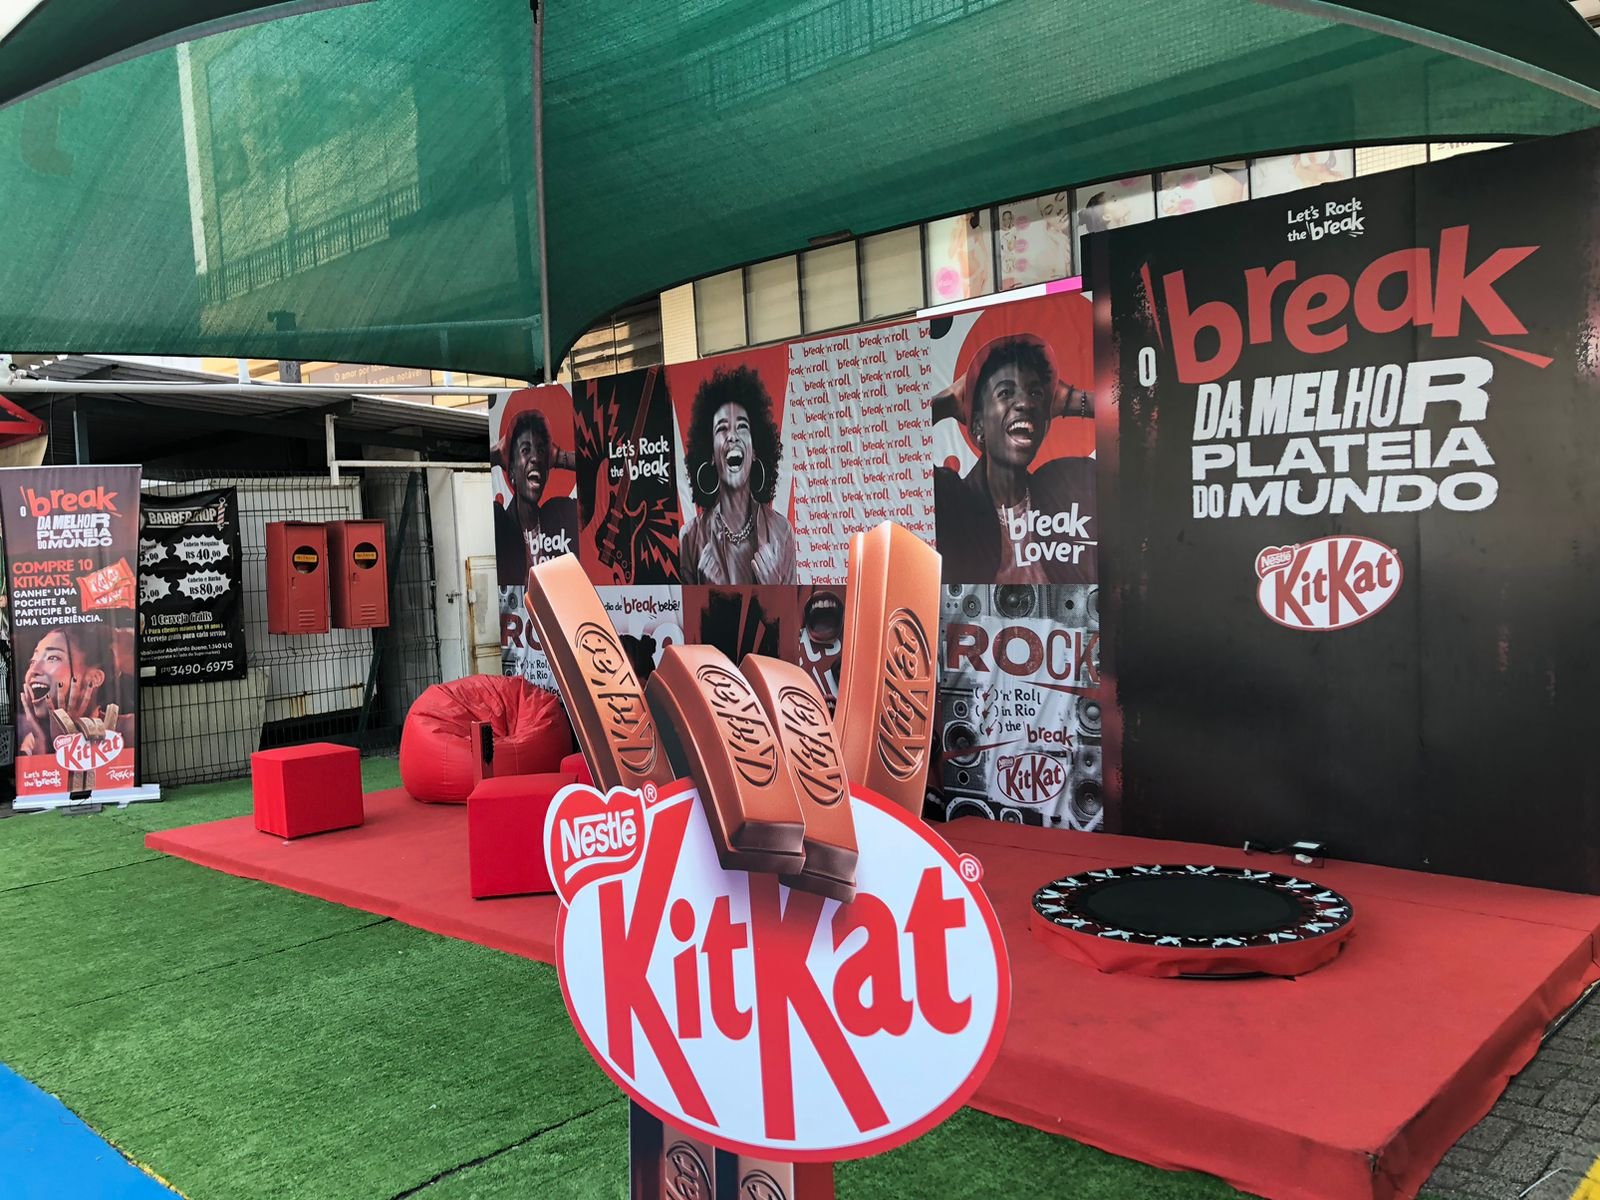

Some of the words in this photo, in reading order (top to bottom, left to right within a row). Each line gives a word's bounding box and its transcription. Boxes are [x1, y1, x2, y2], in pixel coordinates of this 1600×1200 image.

[1287, 205, 1320, 224] Let's
[1325, 197, 1362, 216] Rock
[1287, 229, 1307, 241] the
[1309, 211, 1365, 240] break
[1138, 346, 1157, 387] O
[1162, 225, 1541, 384] break
[1192, 383, 1244, 441] DA
[1248, 356, 1494, 437] MELHOR
[608, 439, 635, 459] Let's
[639, 435, 670, 455] Rock
[1191, 427, 1496, 480] PLATEIA
[610, 465, 624, 478] the
[628, 454, 670, 480] break
[20, 506, 27, 517] O
[27, 486, 118, 517] break
[1192, 483, 1224, 519] DO
[1228, 470, 1499, 518] MUNDO
[36, 528, 112, 540] PLATEIA
[37, 515, 52, 530] DA
[52, 513, 111, 530] MELHOR
[1008, 502, 1093, 540] break
[37, 540, 47, 550] DO
[47, 538, 113, 549] MUNDO
[185, 551, 195, 560] R$
[196, 549, 221, 561] 40,00
[528, 528, 572, 555] break
[1015, 540, 1086, 567] Lover
[12, 560, 75, 574] COMPRE
[78, 559, 93, 571] 10
[13, 574, 73, 588] KITKATS,
[54, 588, 77, 596] UMA
[189, 587, 200, 595] R$
[199, 583, 223, 596] 80,00
[1274, 540, 1393, 626] KitKat
[14, 598, 56, 608] POCHETE
[59, 598, 67, 606] &
[15, 608, 62, 617] PARTICIPE
[615, 602, 623, 611] de
[623, 595, 657, 614] break
[15, 618, 38, 627] UMA
[41, 614, 103, 625] EXPERIÊNCIA.
[947, 623, 1100, 683] ROCK
[536, 671, 548, 680] Rio
[581, 638, 655, 753] KitKat
[879, 624, 929, 768] KitKat
[1014, 688, 1041, 705] Roll
[703, 675, 775, 770] KitKat
[1001, 706, 1012, 716] in
[1015, 704, 1036, 717] Rio
[781, 695, 843, 793] KitKat
[1005, 720, 1021, 732] the
[1026, 723, 1073, 747] break
[63, 735, 120, 769] KitKat
[35, 777, 61, 787] break
[1006, 755, 1061, 801] KitKat
[598, 797, 972, 1142] KitKat
